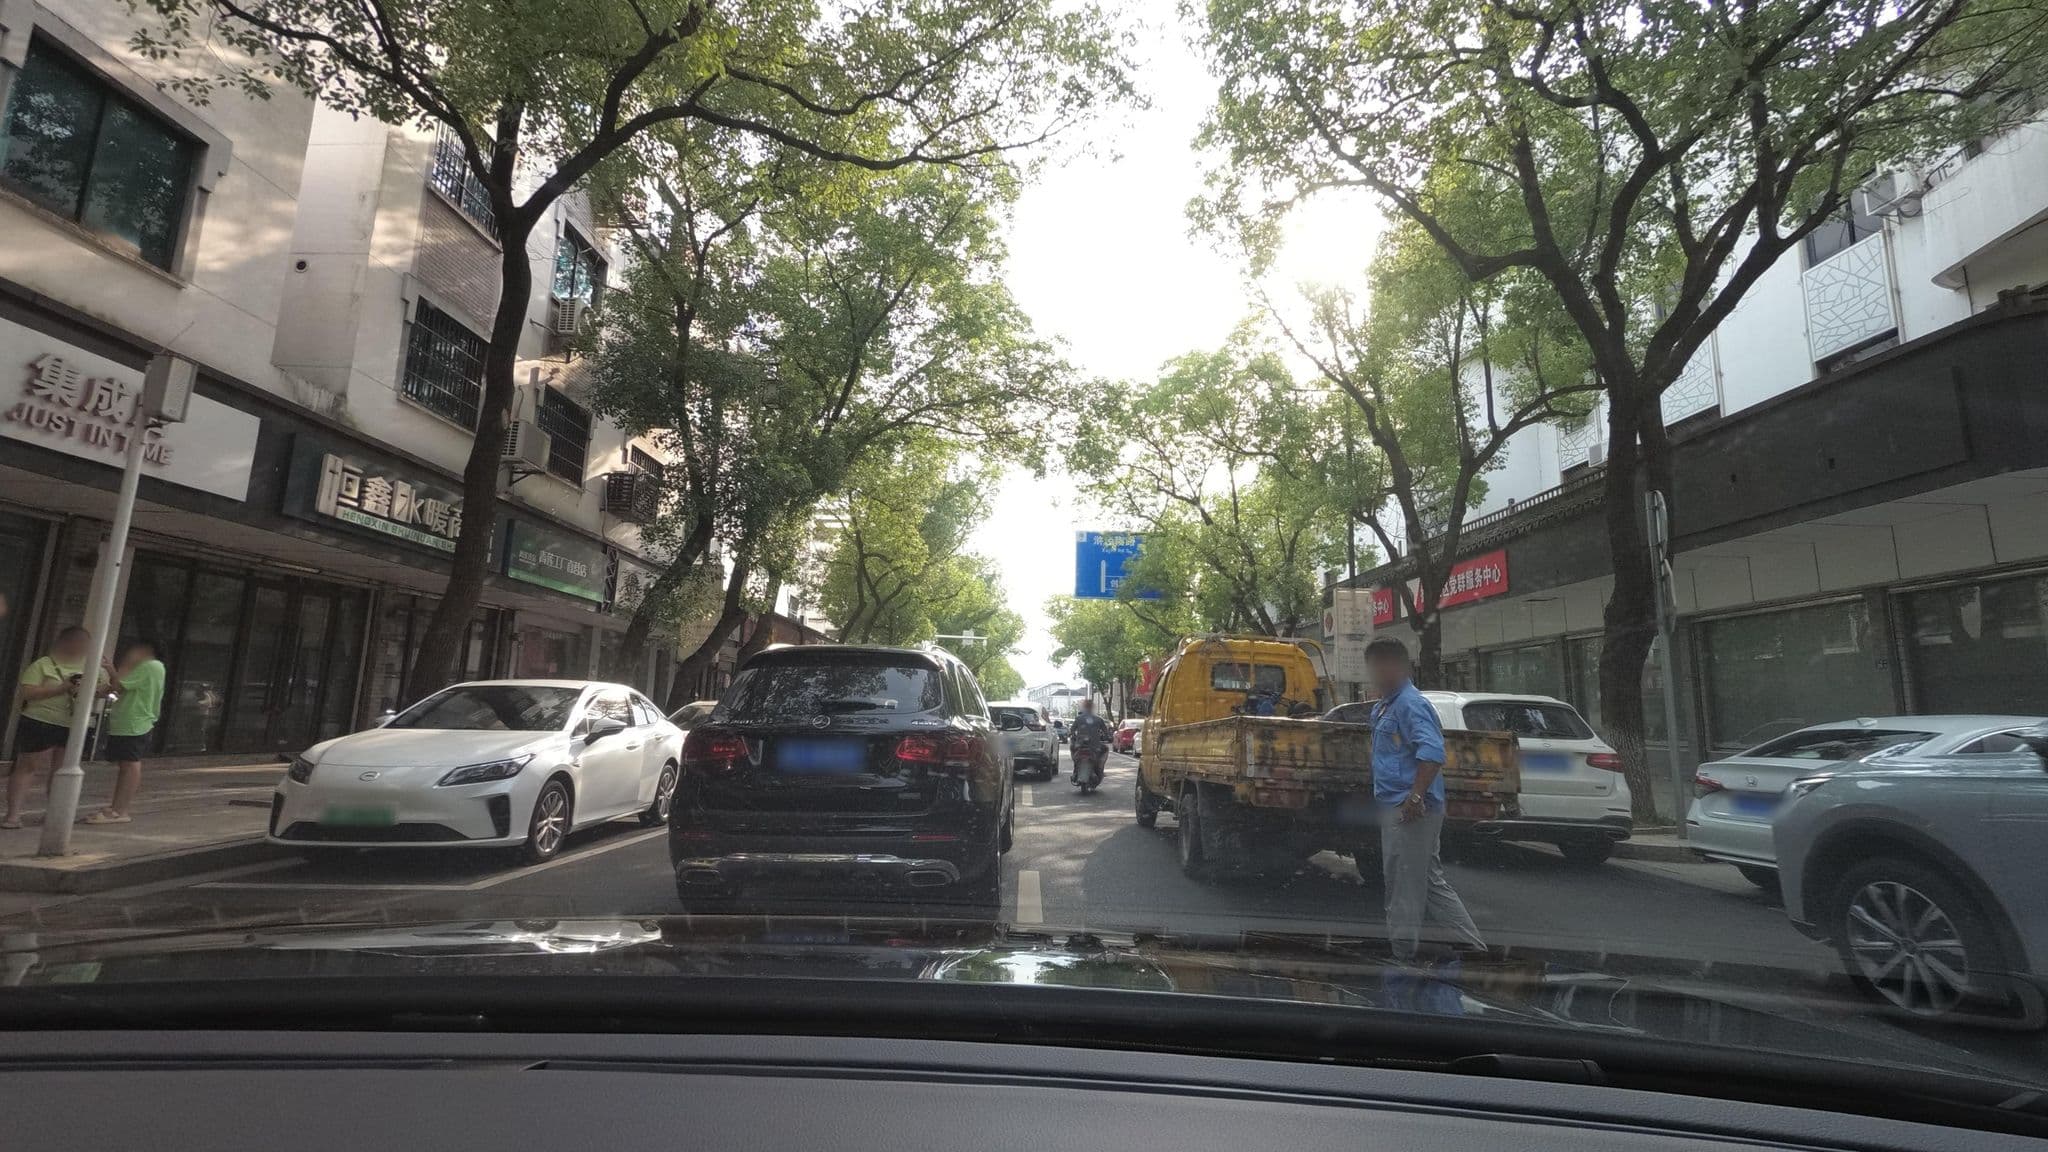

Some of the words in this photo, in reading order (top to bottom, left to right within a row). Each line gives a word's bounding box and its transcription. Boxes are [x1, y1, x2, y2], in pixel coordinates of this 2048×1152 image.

[12, 402, 81, 438] JUST
[88, 422, 115, 449] IN
[114, 431, 171, 465] TME
[342, 510, 389, 531] HENGXIN
